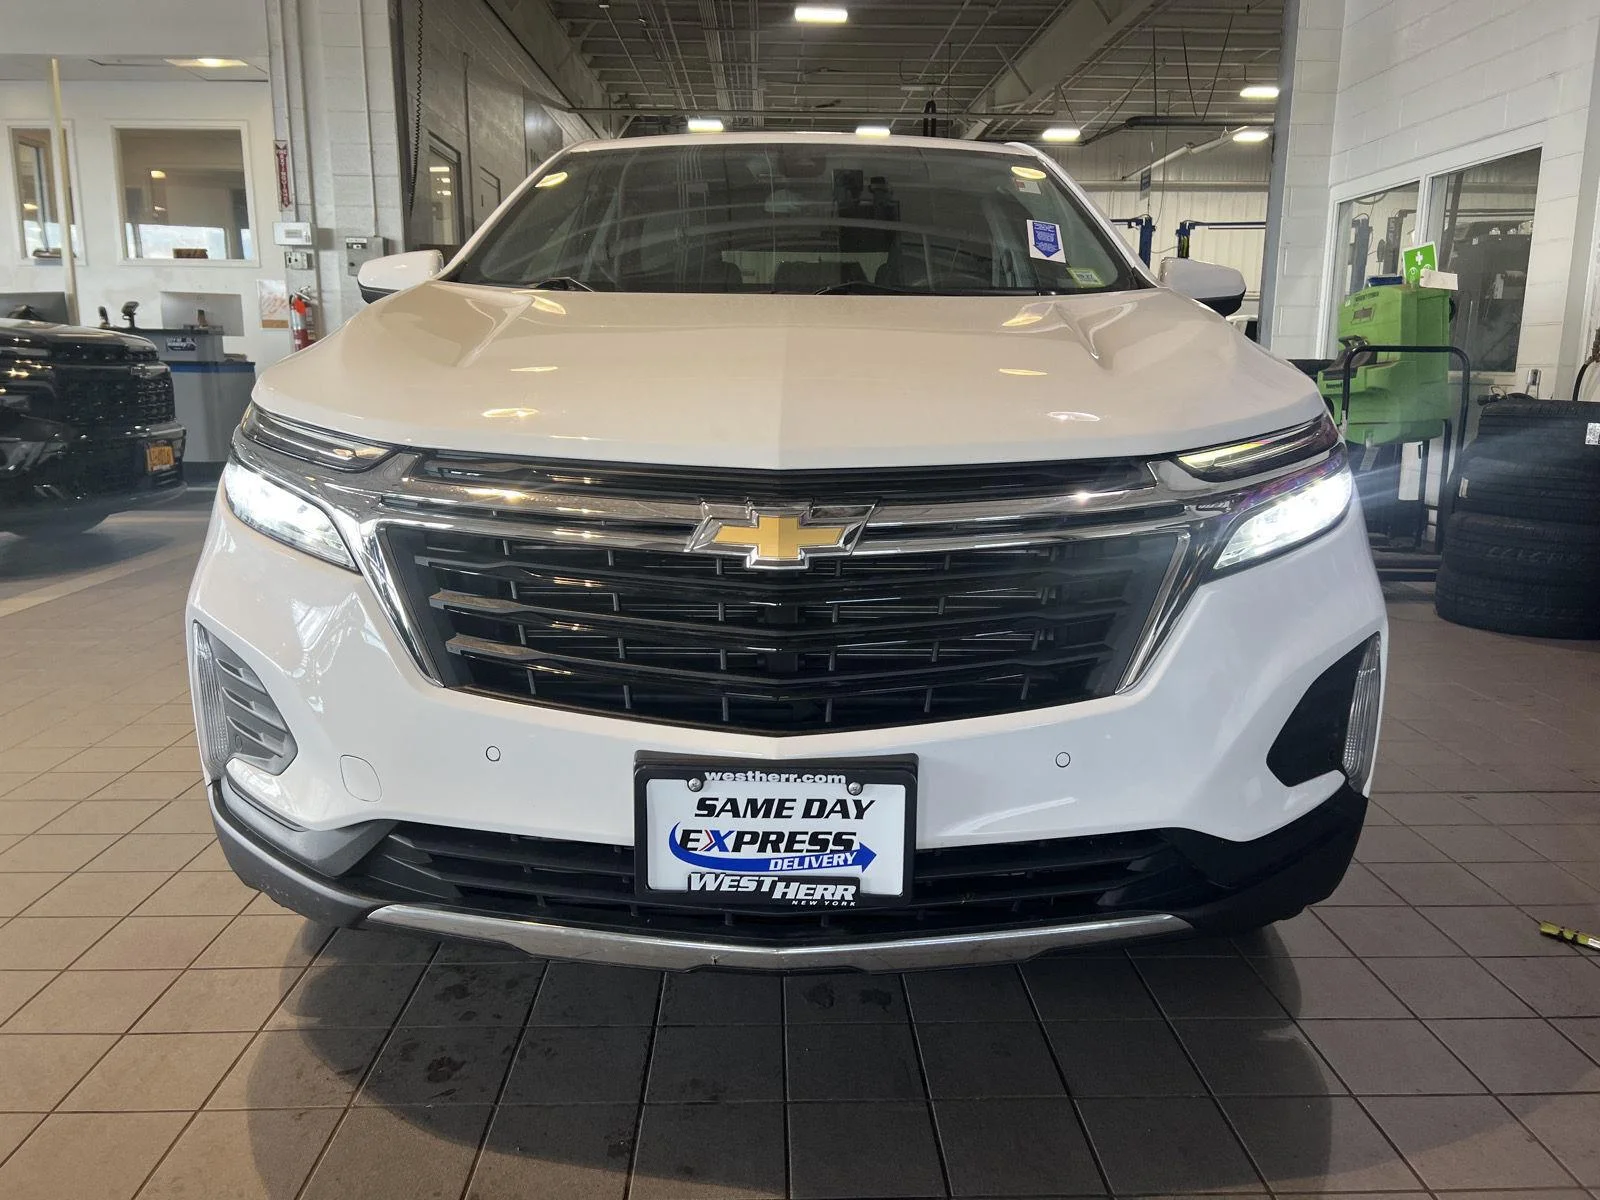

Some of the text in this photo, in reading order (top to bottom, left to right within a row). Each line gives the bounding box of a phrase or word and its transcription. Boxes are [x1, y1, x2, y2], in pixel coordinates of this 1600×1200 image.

[704, 771, 847, 784] westherr.com
[694, 797, 876, 820] SAME DAY
[679, 829, 857, 854] EXPRESS
[768, 852, 857, 871] DELIVERY
[689, 872, 857, 901] WEST HERR
